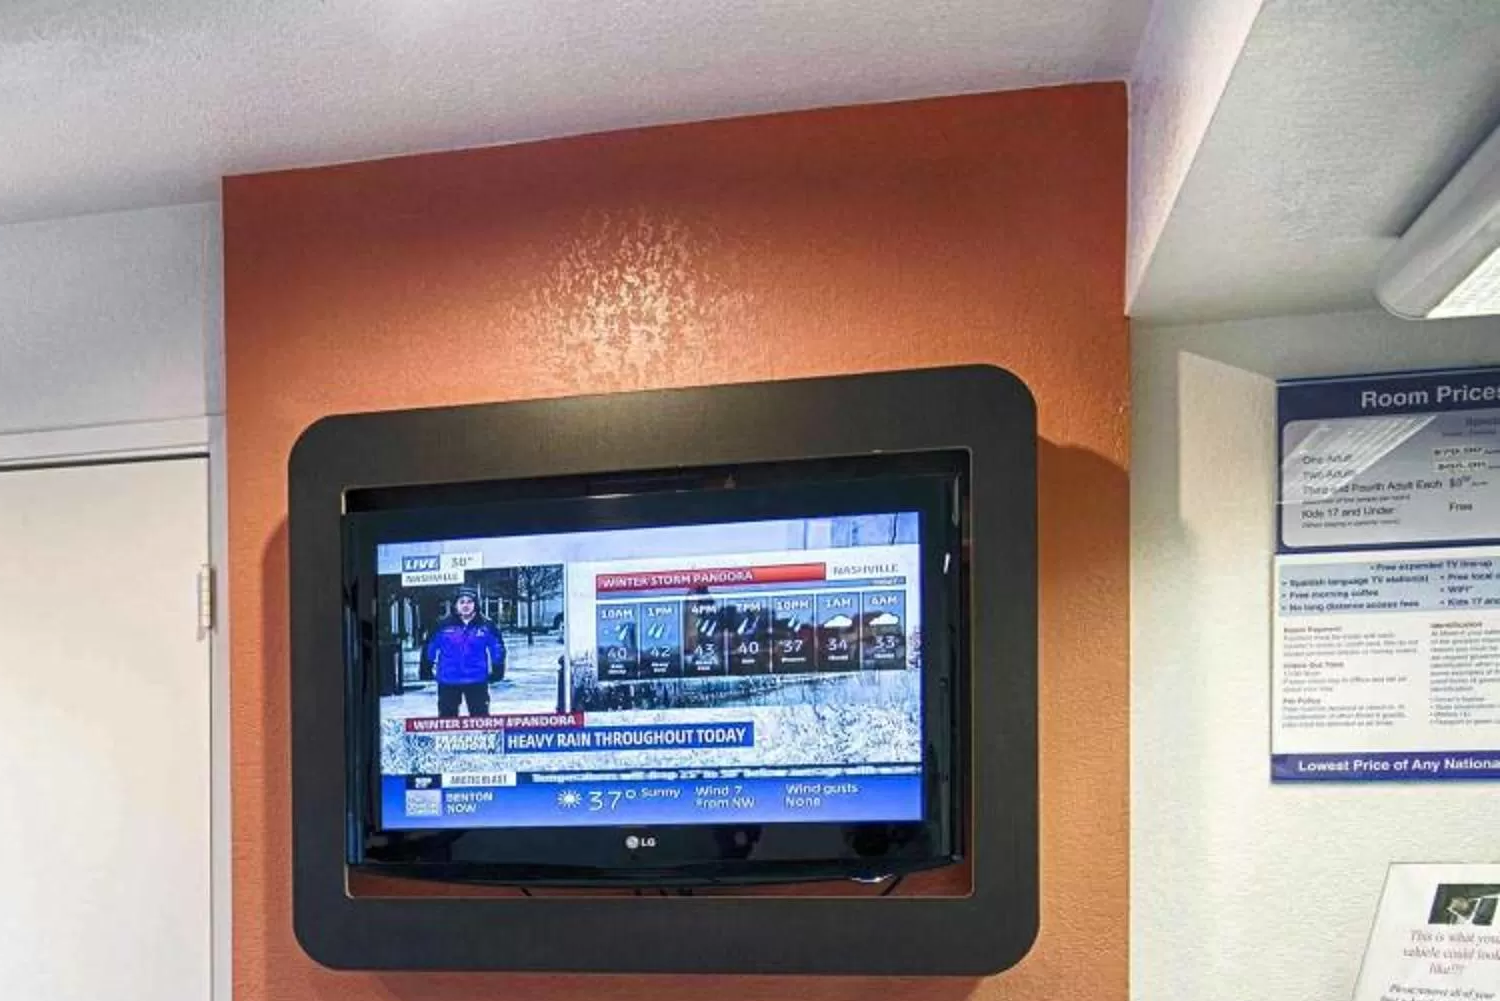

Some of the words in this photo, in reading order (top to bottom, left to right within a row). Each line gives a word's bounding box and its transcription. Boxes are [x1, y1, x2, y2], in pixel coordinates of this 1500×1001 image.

[1361, 390, 1429, 409] Room
[1437, 384, 1500, 403] Price
[1352, 483, 1385, 492] Fourth
[1388, 481, 1413, 490] Adult
[1416, 480, 1443, 489] Each
[1302, 509, 1324, 519] Kids
[1328, 508, 1339, 517] 17
[1342, 507, 1360, 517] and
[1364, 506, 1394, 515] Under
[1450, 502, 1473, 511] Free
[404, 558, 438, 571] LIVE
[833, 564, 899, 576] NASHVILLE
[1447, 561, 1460, 569] TV
[603, 577, 648, 588] WINTER
[650, 574, 691, 586] STORM
[693, 571, 754, 583] PANDORA
[692, 604, 717, 614] 4PM
[776, 600, 809, 610] 10PM
[826, 598, 852, 609] 1AM
[601, 608, 633, 619] 10AM
[648, 607, 672, 617] 1PM
[739, 641, 759, 654] 40
[783, 640, 803, 652] 37
[828, 638, 848, 651] 34
[875, 635, 895, 648] 33
[607, 648, 627, 660] 40
[651, 646, 671, 658] 42
[694, 643, 715, 655] 43
[413, 719, 460, 730] WINTER
[462, 718, 504, 729] STORM
[508, 733, 553, 749] HEAVY
[557, 732, 591, 748] RAIN
[594, 729, 693, 747] THROUGHOUT
[696, 727, 747, 744] TODAY
[1299, 760, 1349, 772] Lowest
[1353, 758, 1390, 771] Price
[1394, 758, 1409, 770] of
[1412, 758, 1440, 773] Any
[642, 788, 681, 799] Sunny
[696, 786, 728, 797] Wind
[735, 785, 743, 796] 7
[786, 784, 820, 794] Wind
[825, 784, 859, 796] gusts
[696, 798, 729, 808] From
[786, 796, 820, 807] None
[448, 803, 477, 813] NOW
[641, 837, 656, 847] LG
